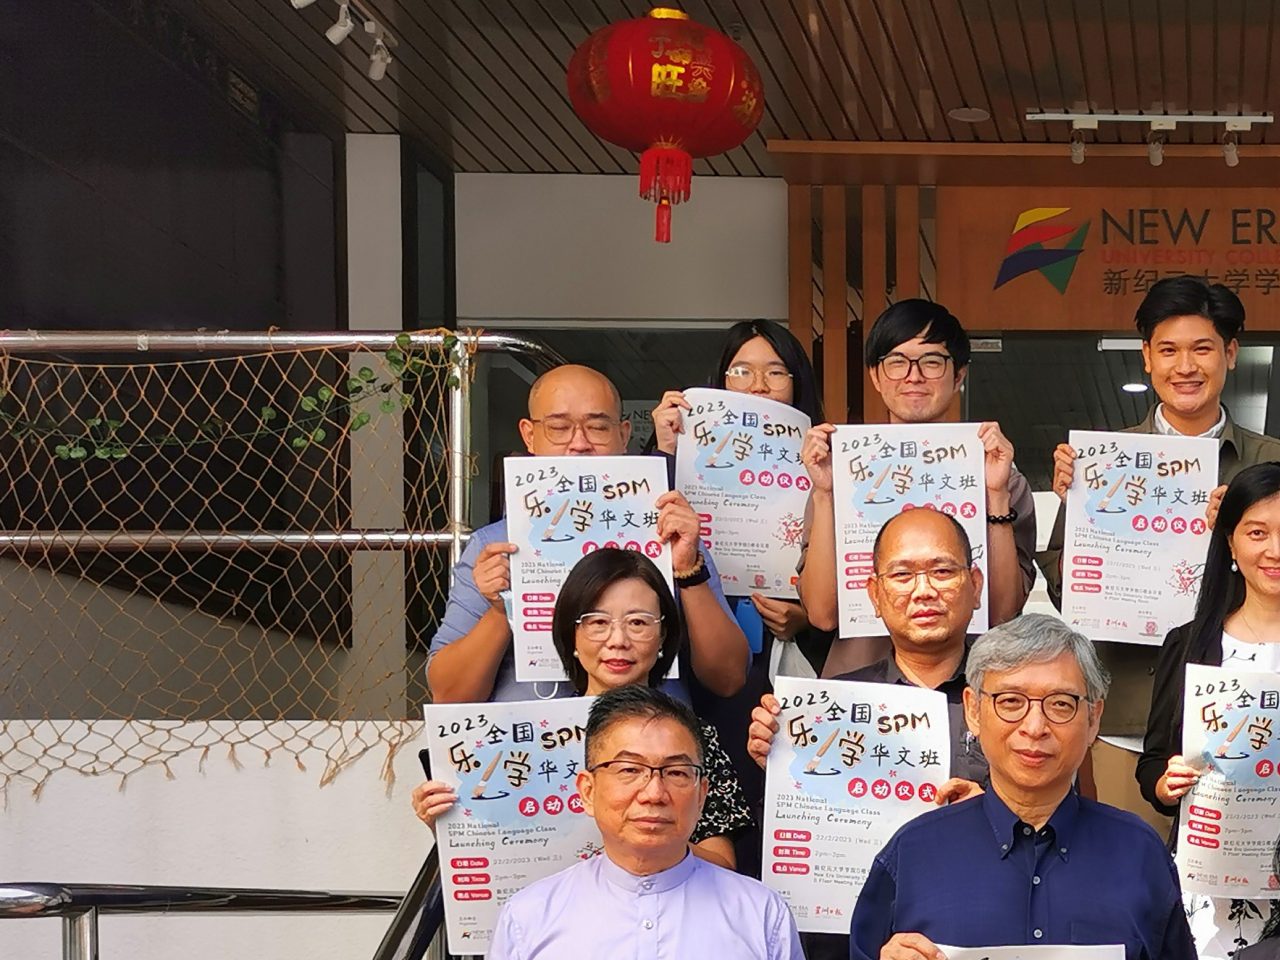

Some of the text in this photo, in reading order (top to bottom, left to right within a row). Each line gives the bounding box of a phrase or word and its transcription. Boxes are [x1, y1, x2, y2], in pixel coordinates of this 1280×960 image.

[1101, 208, 1211, 245] NEW
[1102, 250, 1214, 265] UNIVERSITY
[688, 401, 802, 438] 2023 全国 SPM
[842, 434, 967, 464] 2023 全国 SPM
[1077, 442, 1201, 476] 2023 全国 SPM
[515, 466, 650, 500] 2023 全国 SPM
[1195, 679, 1241, 696] 2023
[1237, 689, 1279, 709] 全国
[781, 690, 930, 733] 2023 全国 SPM
[439, 715, 488, 737] 2023
[485, 722, 534, 744] 全国
